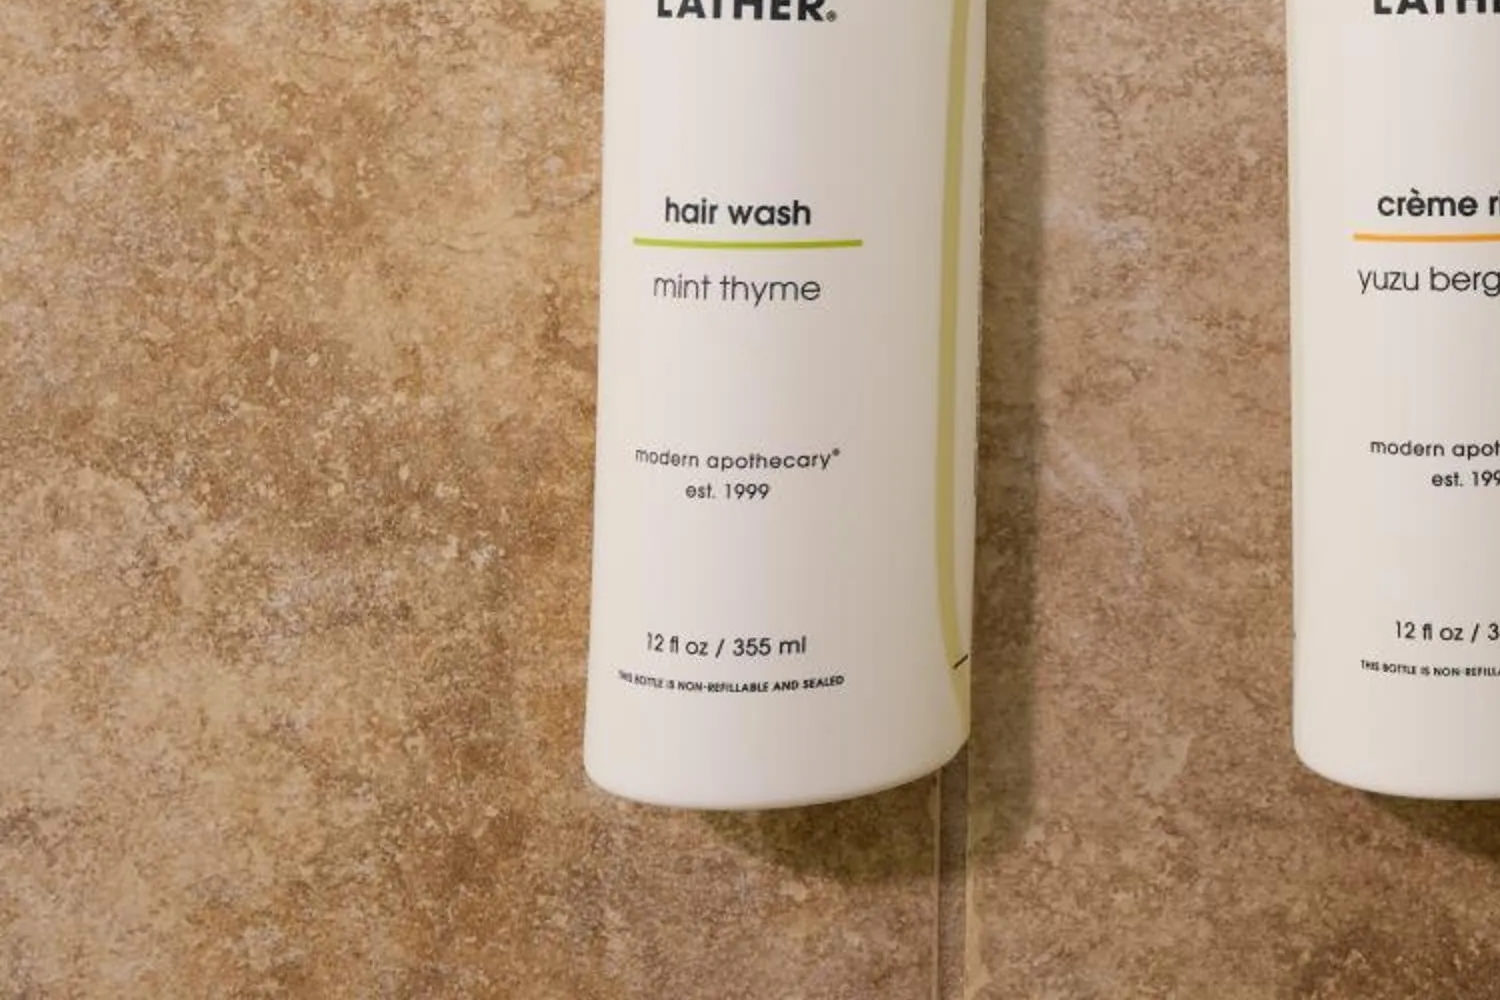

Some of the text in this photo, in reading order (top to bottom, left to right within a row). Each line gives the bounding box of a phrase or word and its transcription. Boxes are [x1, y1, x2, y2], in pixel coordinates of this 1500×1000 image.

[664, 195, 812, 227] hair wash
[1377, 187, 1479, 218] crème
[653, 273, 822, 308] mint thyme
[1357, 269, 1420, 295] yuzu
[635, 449, 700, 469] modern
[1369, 439, 1446, 457] modern
[1431, 471, 1464, 488] est.
[685, 482, 771, 501] est. 1999
[1395, 619, 1417, 641] 12
[1421, 622, 1433, 641] fl
[1439, 626, 1465, 642] oz
[1470, 622, 1481, 644] /
[647, 631, 807, 659] 12 fl oz / 355 ml
[1360, 658, 1381, 672] THIS
[1381, 662, 1417, 676] BOTTLE
[771, 679, 800, 692] AND
[801, 674, 845, 690] SEALED
